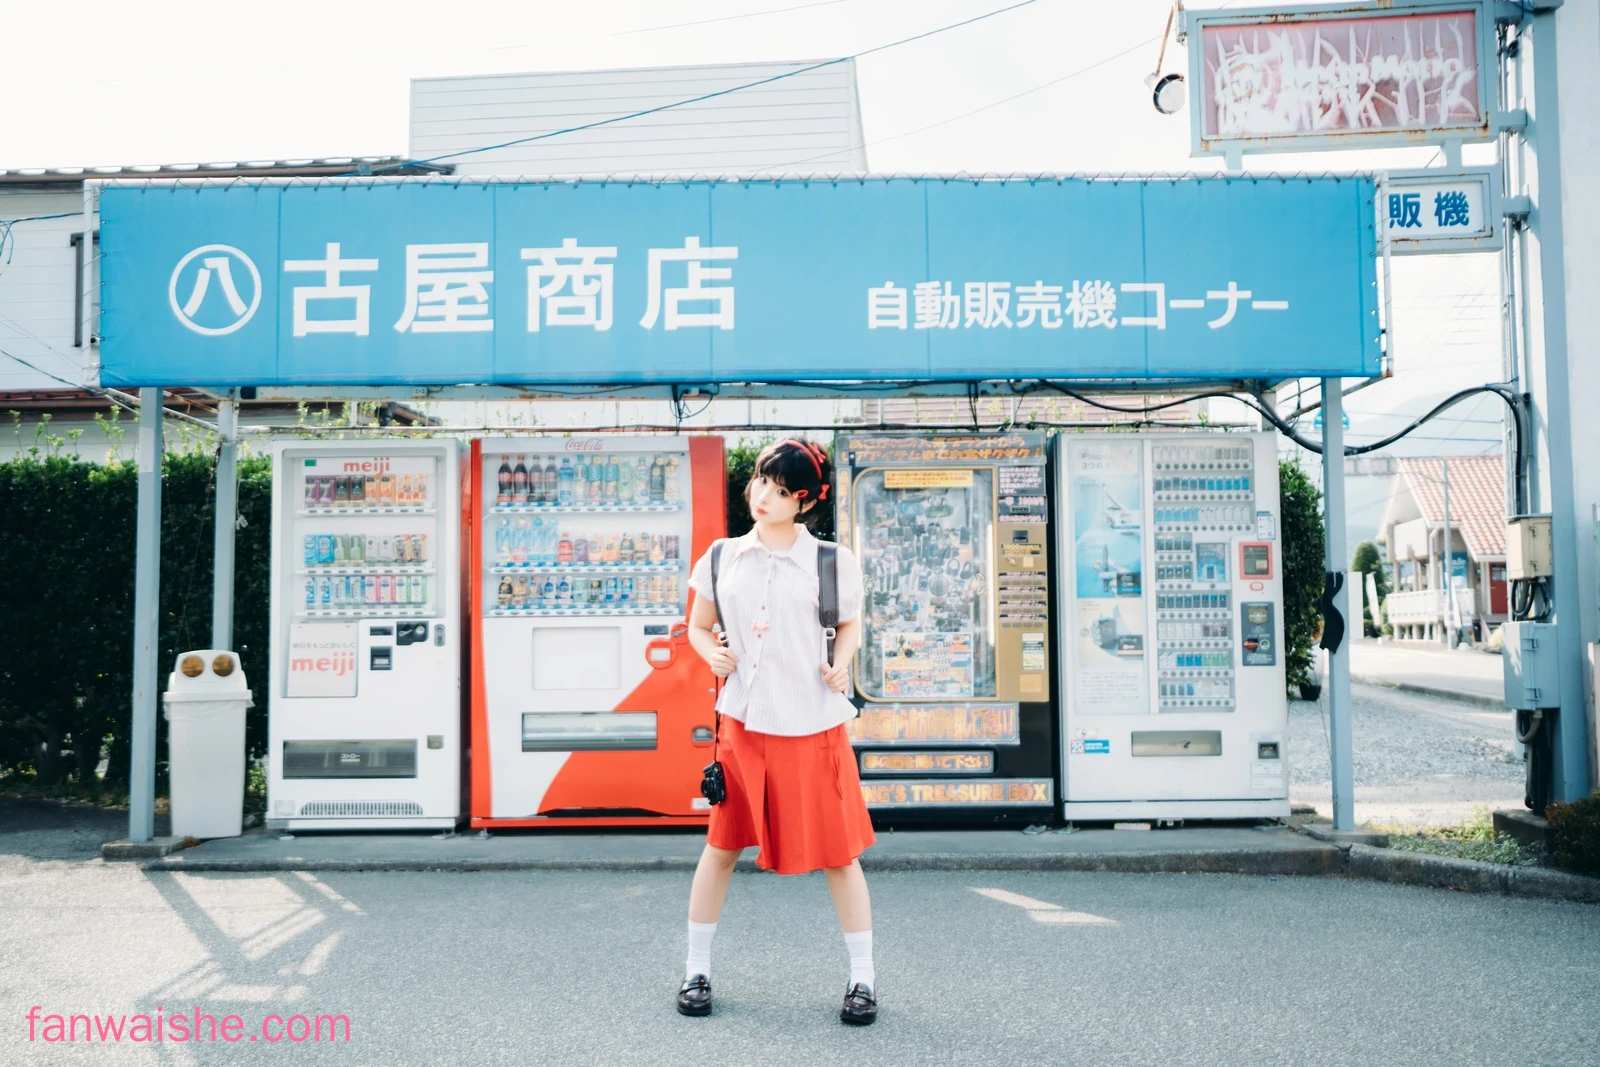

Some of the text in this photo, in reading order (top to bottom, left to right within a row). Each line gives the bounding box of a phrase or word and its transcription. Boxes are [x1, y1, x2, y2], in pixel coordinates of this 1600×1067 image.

[283, 236, 740, 337] 古屋商店
[867, 280, 1290, 331] 自動販売機コーナー
[343, 457, 391, 475] meiji
[291, 652, 355, 677] meiji
[911, 783, 1005, 802] TREASURE
[1008, 783, 1048, 802] BOX
